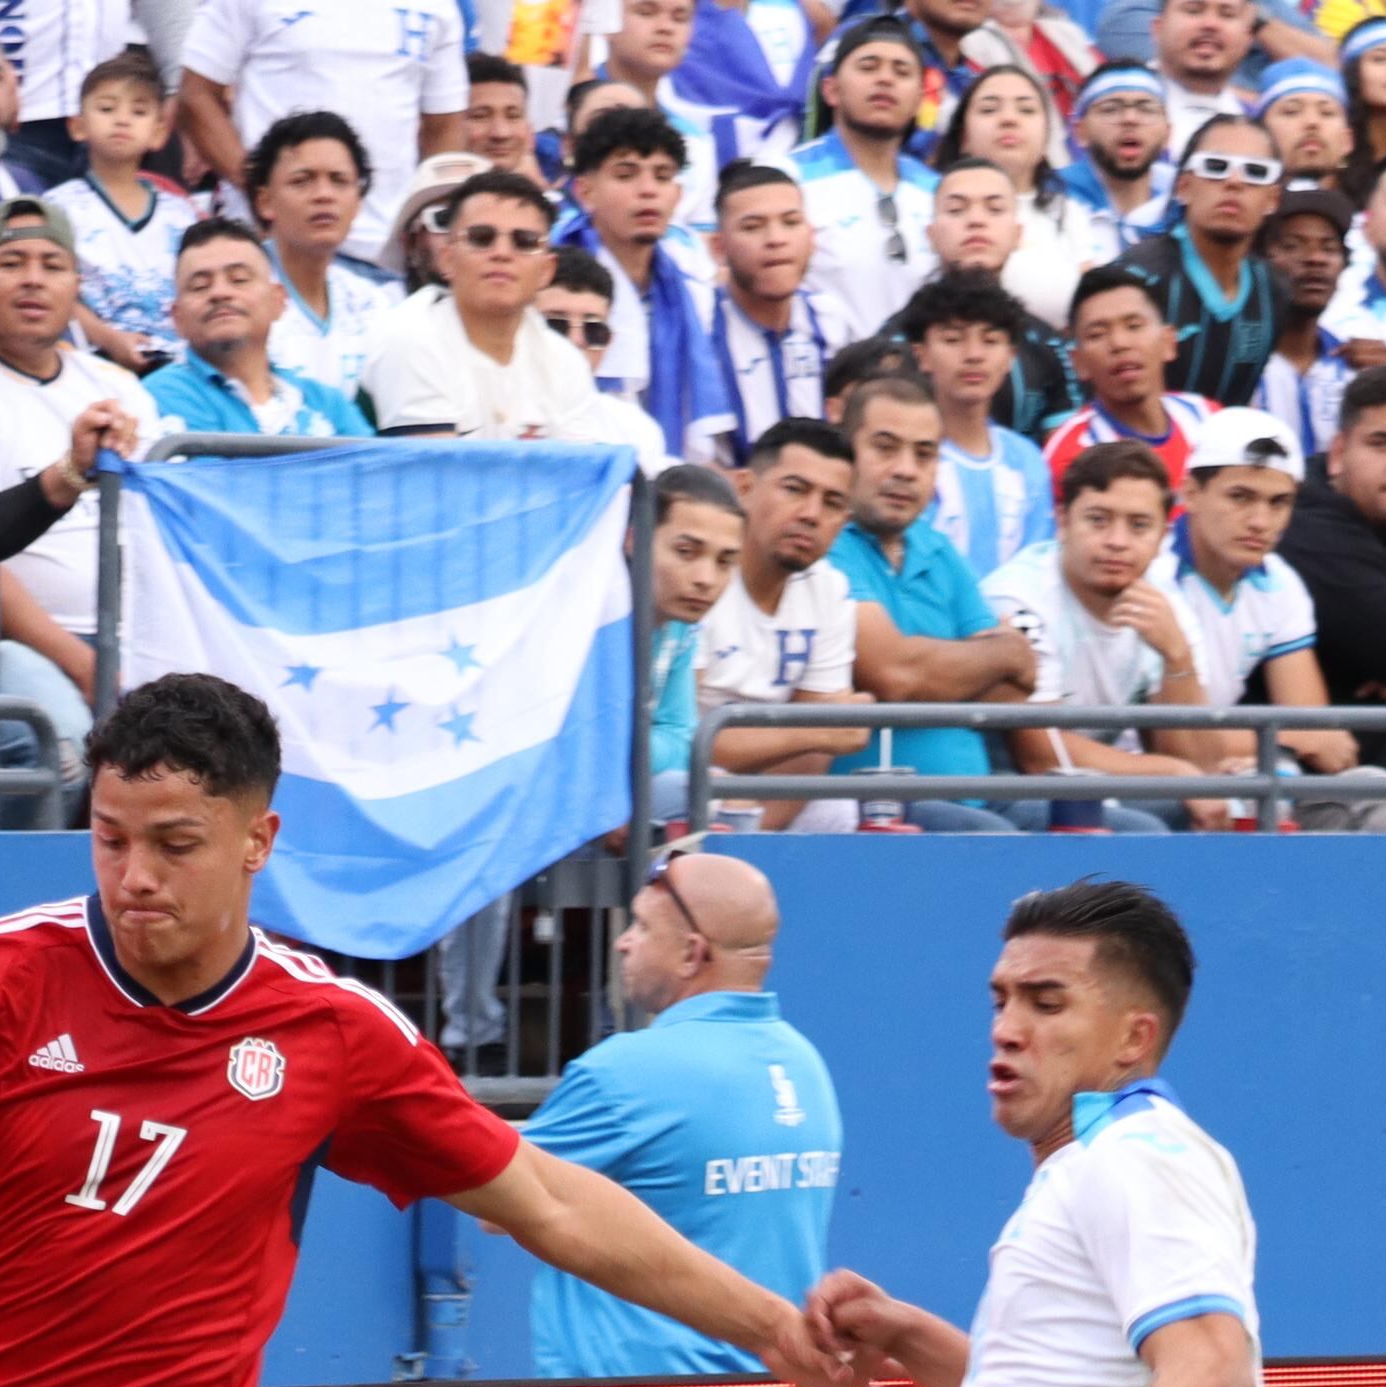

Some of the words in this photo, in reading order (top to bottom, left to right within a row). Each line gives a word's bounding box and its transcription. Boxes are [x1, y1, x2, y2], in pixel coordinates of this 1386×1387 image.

[772, 628, 817, 687] H
[28, 1054, 85, 1073] adidas
[241, 1049, 272, 1089] CR
[65, 1110, 187, 1216] 17
[704, 1152, 797, 1195] EVENT
